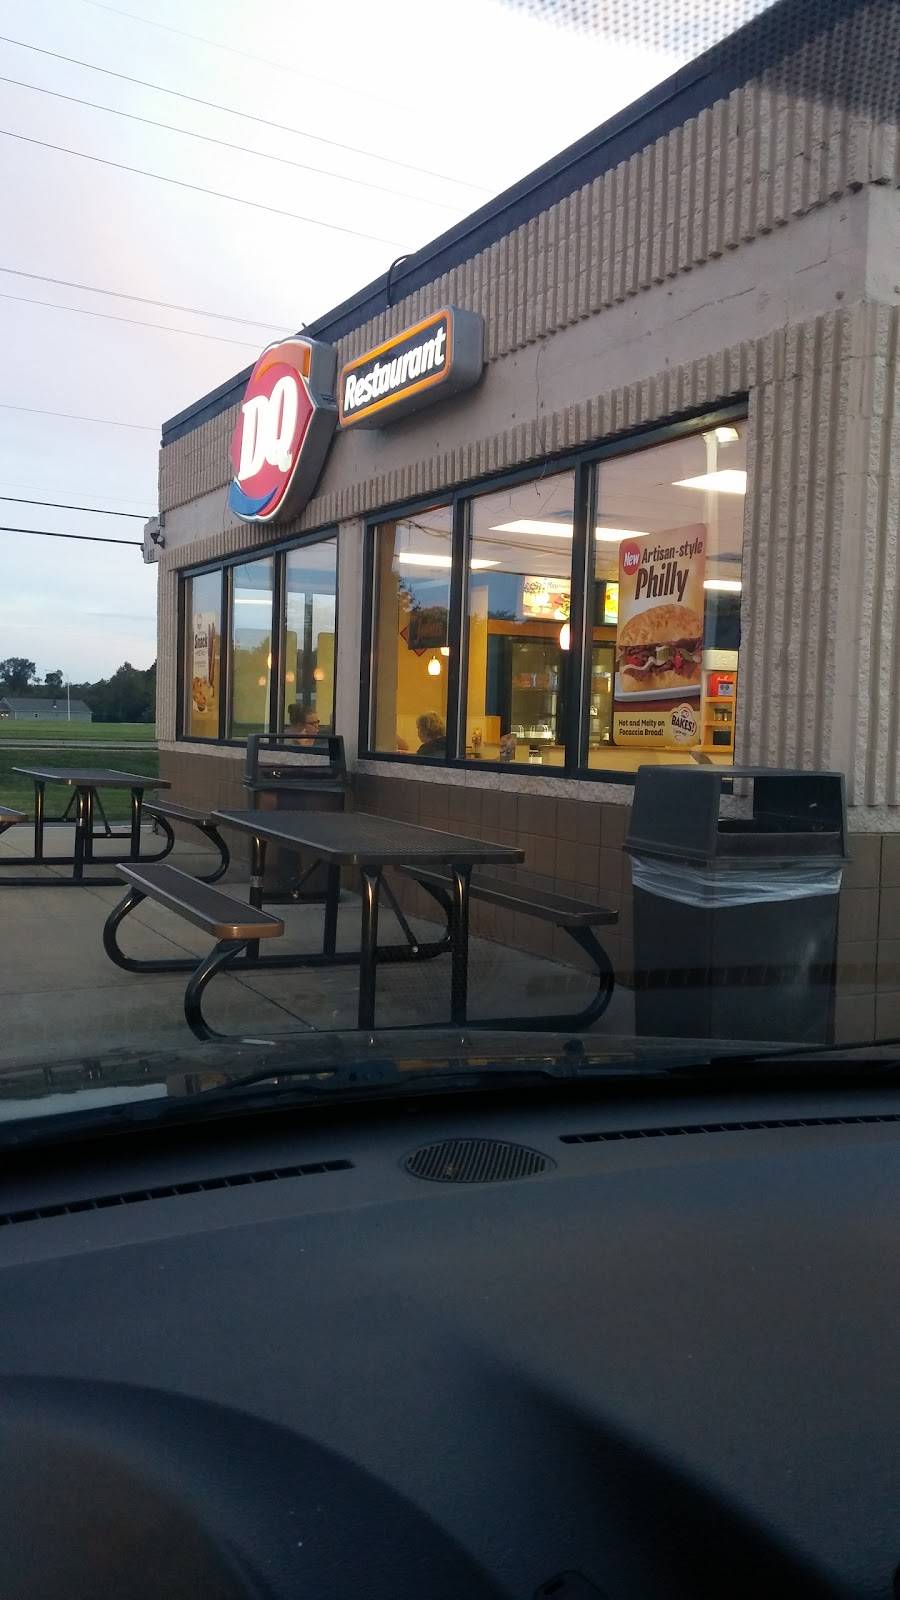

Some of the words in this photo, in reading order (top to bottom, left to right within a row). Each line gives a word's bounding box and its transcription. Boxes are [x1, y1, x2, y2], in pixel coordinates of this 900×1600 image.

[344, 326, 446, 411] Restaurant
[238, 376, 299, 481] DQ
[624, 551, 640, 567] New
[641, 537, 703, 564] Artisan-style
[635, 561, 689, 602] Philly
[195, 633, 207, 649] Snack
[619, 728, 643, 736] Focaccia
[644, 728, 664, 736] Bread!
[641, 719, 657, 728] Melty
